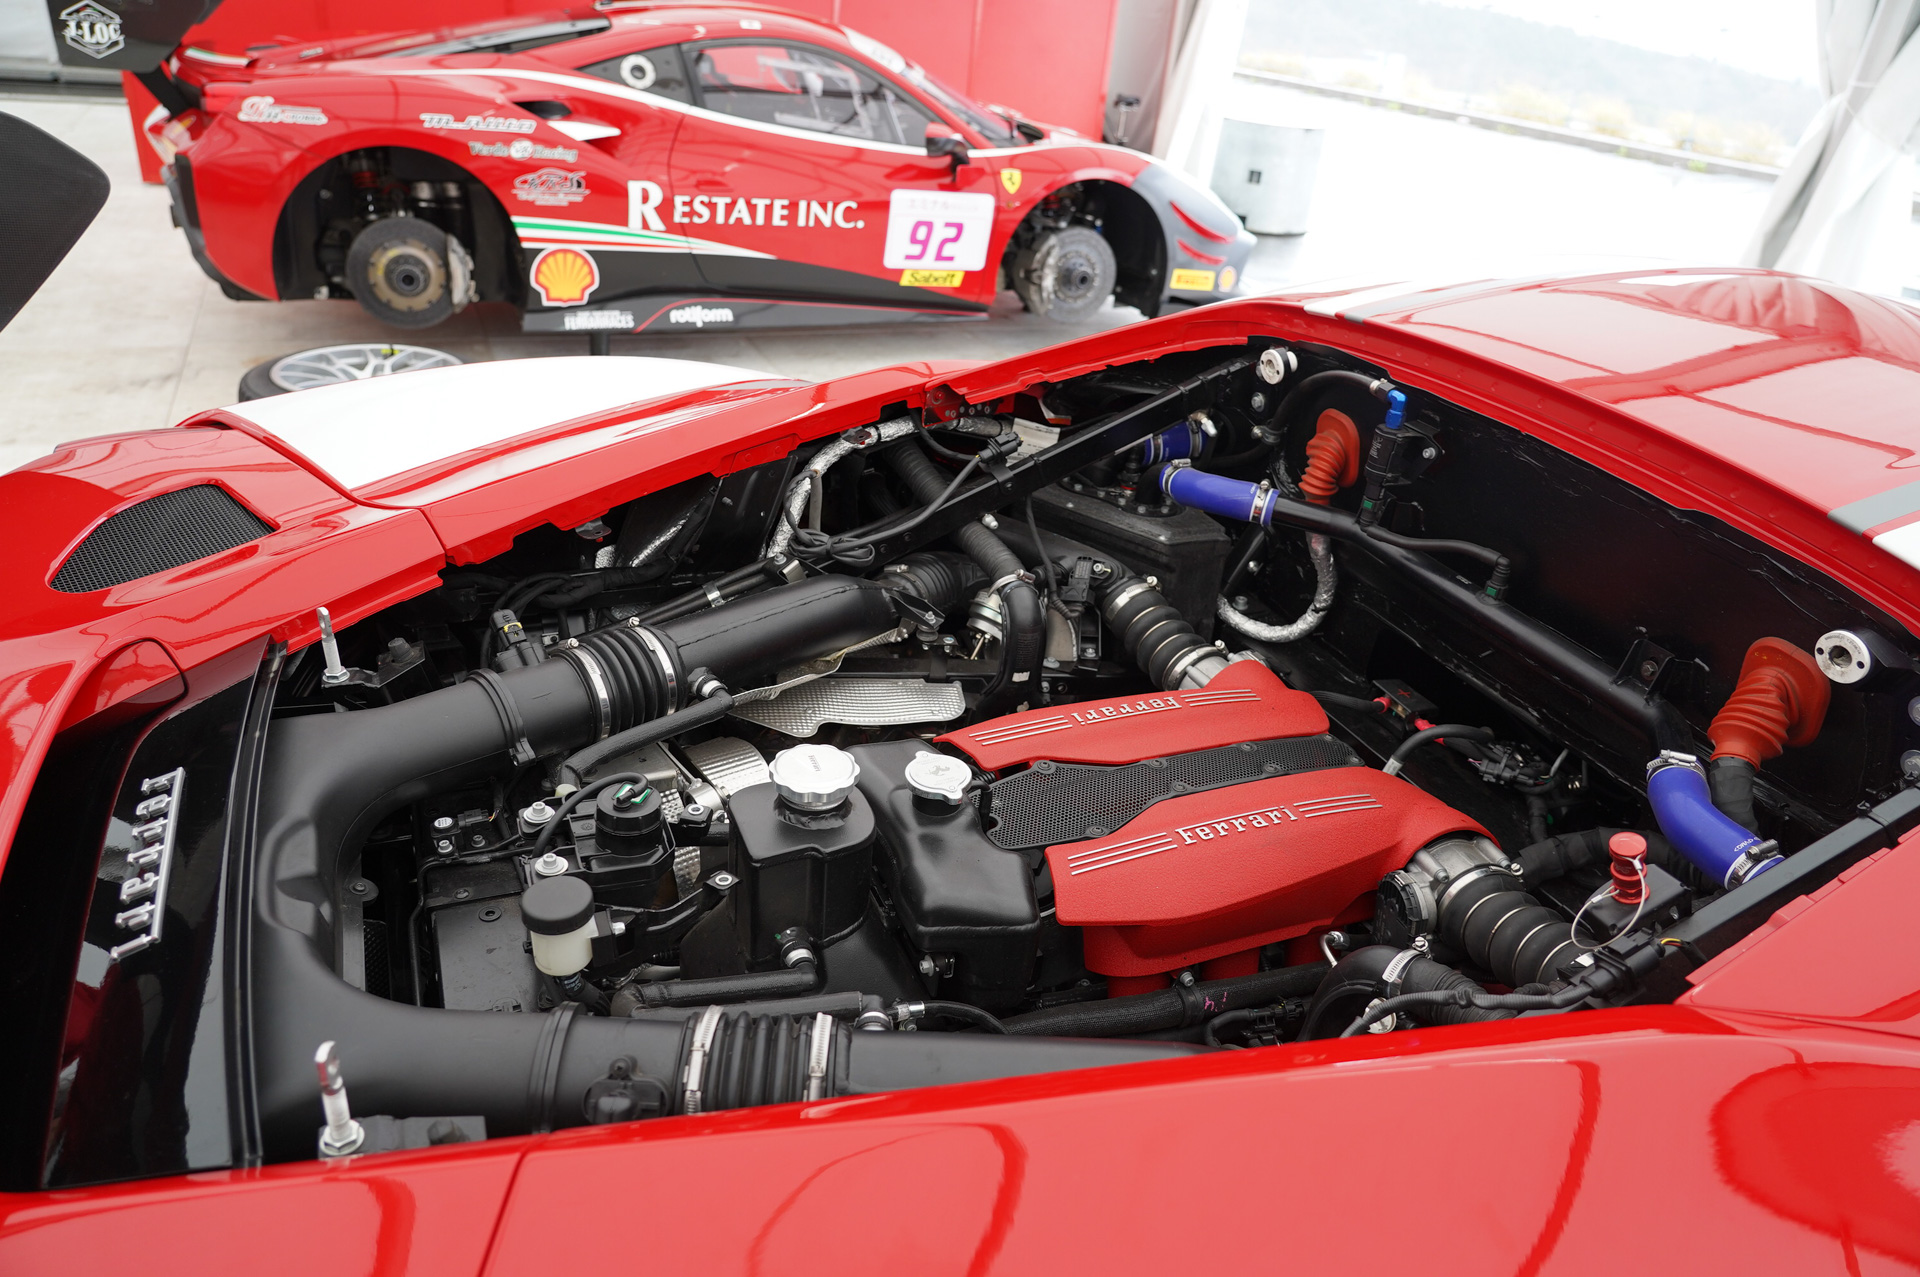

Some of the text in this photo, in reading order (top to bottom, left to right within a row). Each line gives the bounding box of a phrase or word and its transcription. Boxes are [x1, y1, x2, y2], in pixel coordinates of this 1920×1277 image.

[627, 180, 865, 231] R ESTATE INC.
[904, 221, 964, 261] 92
[1071, 696, 1182, 725] Ferrari
[1175, 806, 1298, 845] Ferrari
[110, 767, 186, 962] Ferrari
